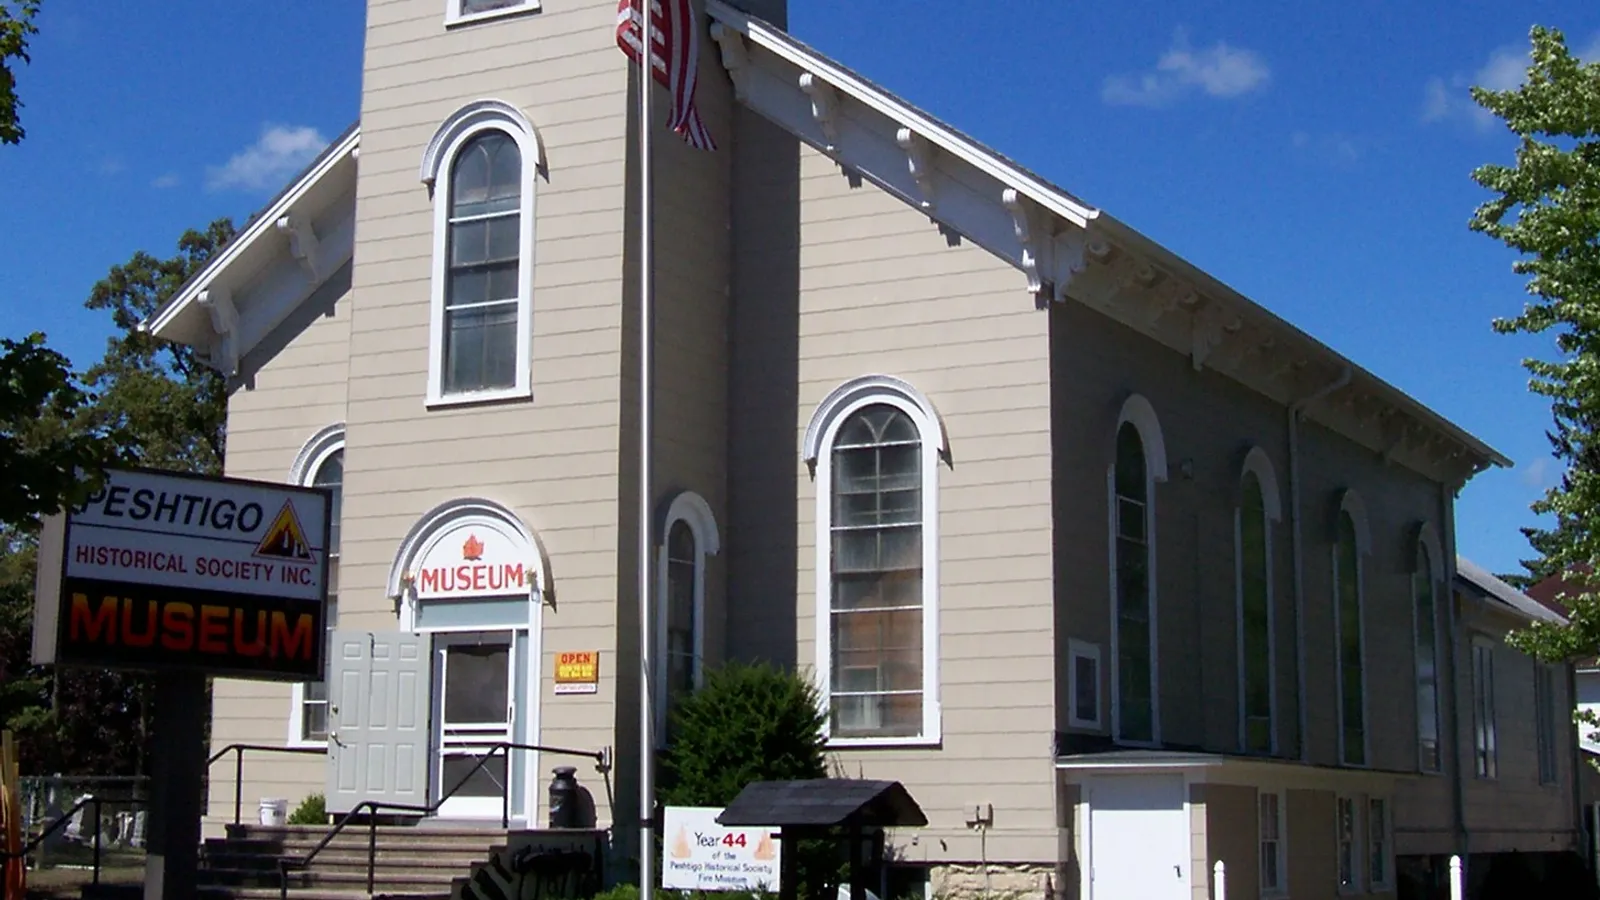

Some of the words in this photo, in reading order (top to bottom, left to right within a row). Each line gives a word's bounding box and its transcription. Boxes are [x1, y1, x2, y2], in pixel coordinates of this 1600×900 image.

[81, 485, 264, 533] PESHTIGO
[75, 545, 187, 573] HISTORICAL
[196, 557, 274, 582] SOCIETY
[281, 566, 316, 586] INC.
[421, 563, 524, 592] MUSEUM
[70, 592, 313, 661] MUSEUM
[561, 652, 590, 664] OPEN
[694, 831, 721, 847] Year
[722, 833, 747, 847] 44
[712, 851, 721, 860] of
[724, 852, 736, 860] the
[670, 861, 702, 872] Peshtigo
[704, 862, 740, 872] Historical
[743, 863, 772, 874] Society
[698, 874, 712, 882] Fire
[715, 874, 747, 883] Museum
